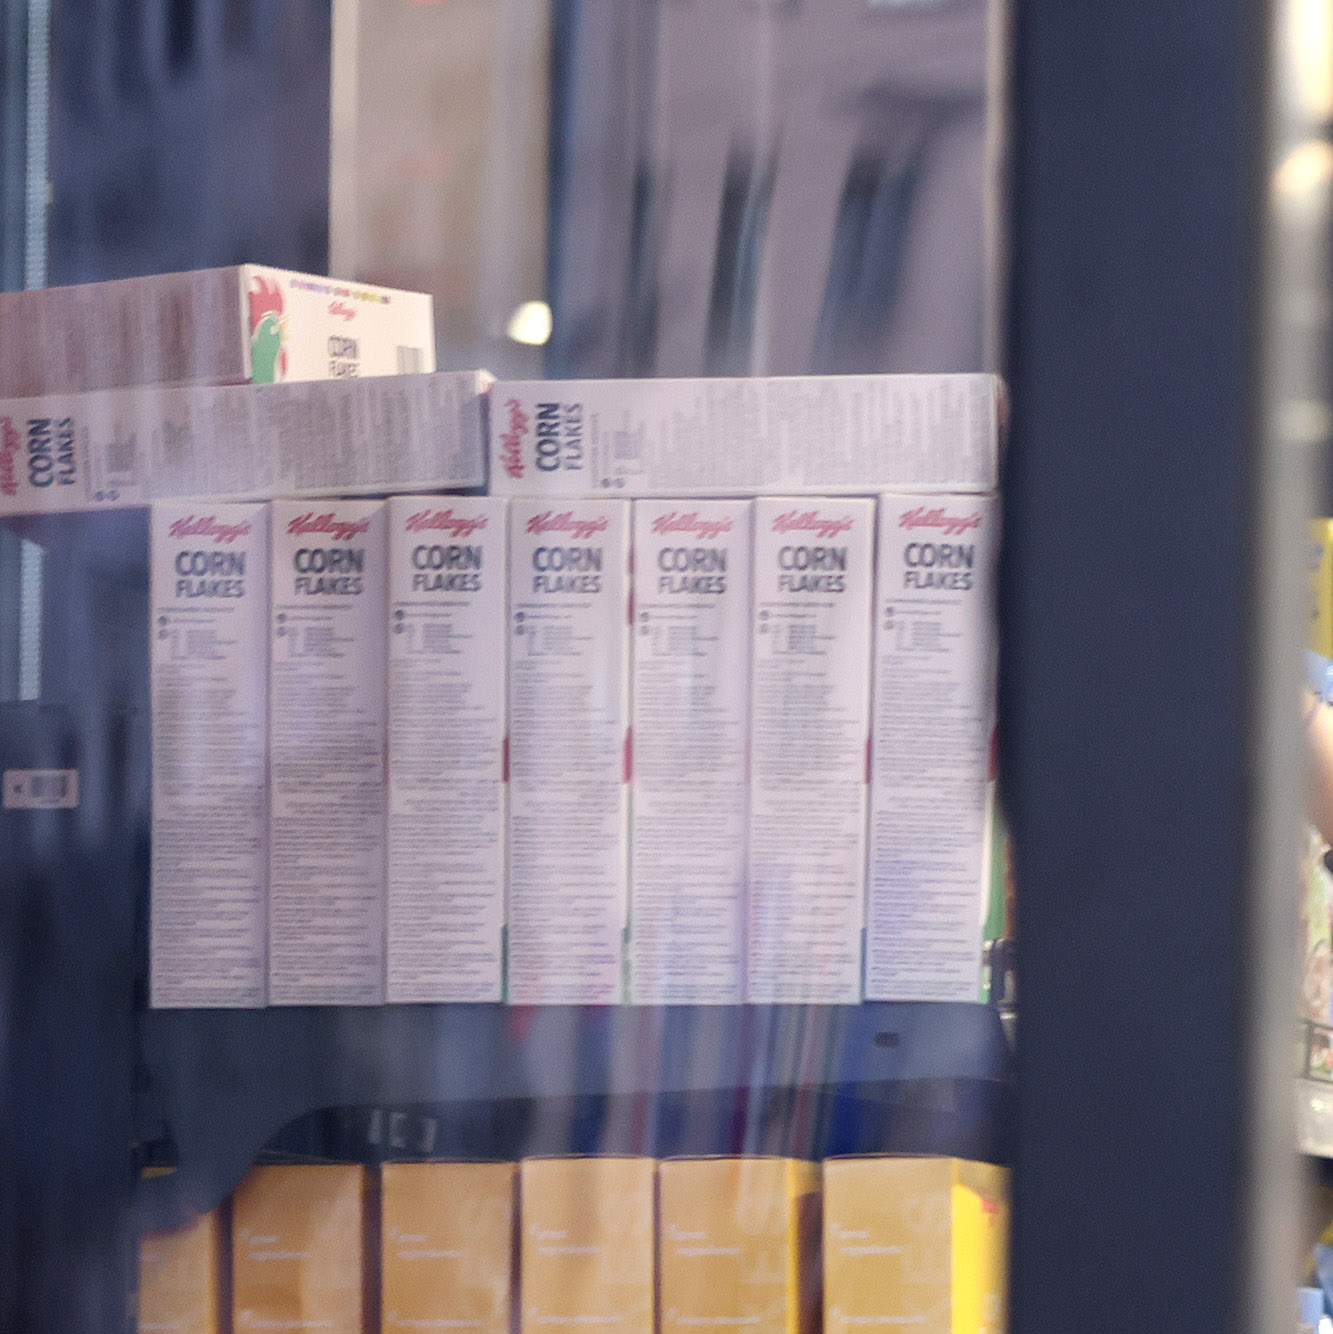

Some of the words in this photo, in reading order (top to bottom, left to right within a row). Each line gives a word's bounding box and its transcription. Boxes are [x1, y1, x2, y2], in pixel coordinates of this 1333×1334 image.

[536, 402, 561, 472] CORN
[564, 402, 584, 470] FLAKES
[27, 418, 54, 488] CORN
[175, 551, 246, 576] CORN
[293, 548, 365, 574] CORN
[412, 545, 483, 571] CORN
[532, 546, 603, 572] CORN
[657, 547, 727, 573] CORN
[778, 546, 848, 571] CORN
[904, 542, 975, 568] CORN
[175, 579, 245, 599] FLAKES
[294, 577, 363, 596] FLAKES
[412, 573, 482, 593] FLAKES
[532, 574, 602, 594] FLAKES
[658, 576, 726, 595] FLAKES
[778, 574, 846, 593] FLAKES
[904, 570, 974, 591] FLAKES
